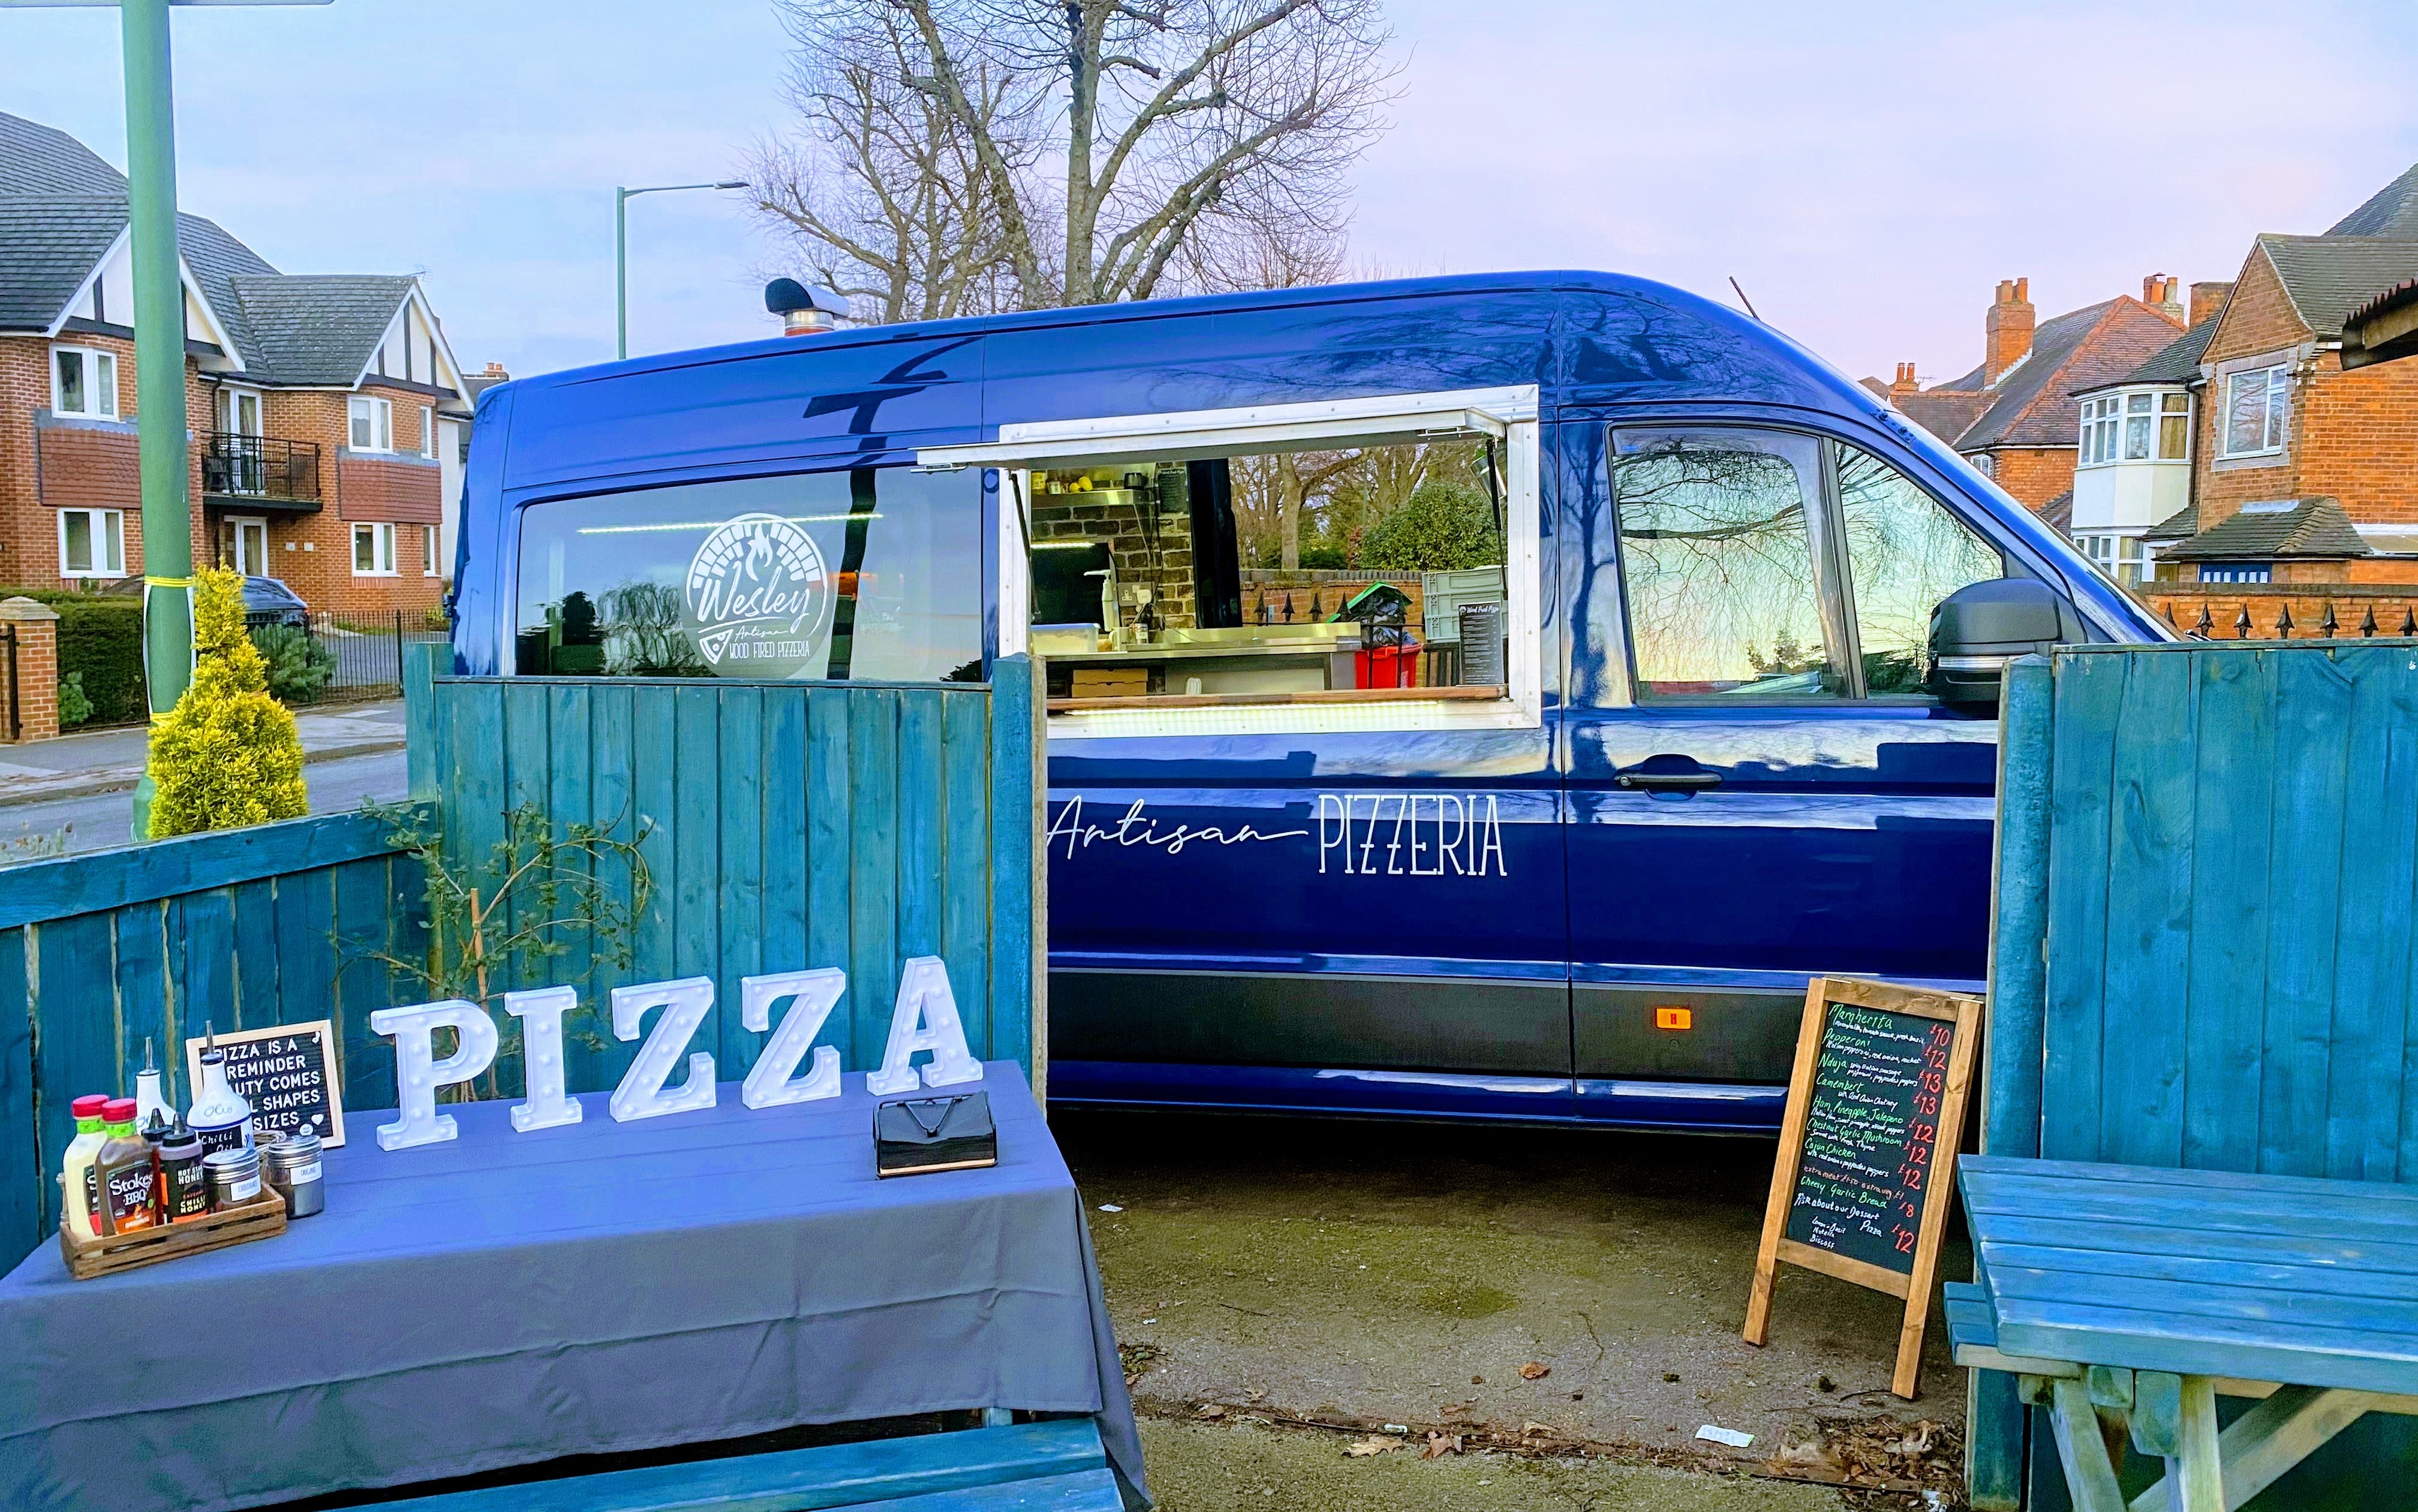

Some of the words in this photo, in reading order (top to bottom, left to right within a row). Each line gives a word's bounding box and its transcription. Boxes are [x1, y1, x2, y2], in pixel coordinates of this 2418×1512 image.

[697, 561, 810, 634] Wesley
[734, 625, 788, 642] Artisan
[729, 643, 749, 659] WOOD
[753, 641, 775, 658] FIRED
[777, 640, 810, 658] PIZZERIA
[1047, 795, 1308, 859] Artisan
[1318, 794, 1508, 877] PIZZERIA
[1828, 1004, 1893, 1029] Margherita
[268, 1040, 282, 1055] IS
[287, 1038, 297, 1053] A
[1822, 1028, 1872, 1047] Pepperoni
[371, 955, 983, 1152] PIZZA
[1818, 1053, 1847, 1073] Nduja
[226, 1055, 306, 1080] REMINDER
[269, 1070, 320, 1091] COMES
[1816, 1073, 1866, 1092] Camembert
[263, 1089, 320, 1111] SHAPES
[1873, 1096, 1899, 1113] Chutney
[253, 1111, 300, 1131] SIZES
[201, 1131, 233, 1145] Chilli
[1806, 1117, 1839, 1133] Chestnut
[1839, 1125, 1861, 1140] Garlic
[1861, 1130, 1903, 1147] Mushroom
[1805, 1137, 1825, 1152] Cajun
[1825, 1142, 1857, 1160] Chicken
[109, 1172, 154, 1196] Stokes
[178, 1171, 204, 1185] HONEY
[1803, 1165, 1822, 1176] extra
[1822, 1170, 1840, 1181] meat
[1861, 1182, 1881, 1193] extra
[124, 1188, 147, 1206] BBQ
[181, 1194, 206, 1208] CHILLI
[1800, 1176, 1826, 1194] Cheesy
[1830, 1183, 1856, 1198] Garlic
[1858, 1191, 1888, 1209] Bread
[181, 1201, 206, 1214] HONEY
[1811, 1198, 1834, 1210] about
[1846, 1206, 1880, 1221] Dessert
[1812, 1226, 1835, 1239] Nutella
